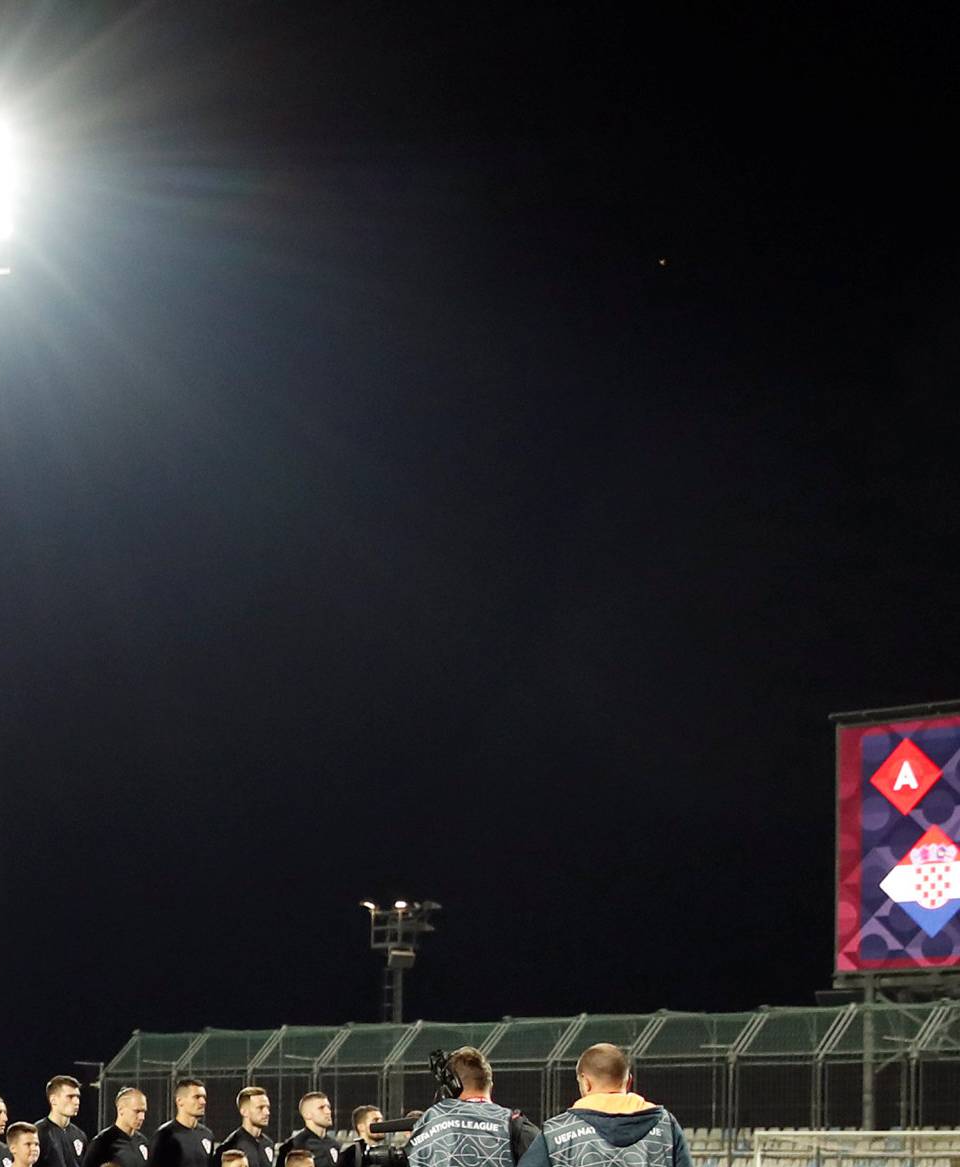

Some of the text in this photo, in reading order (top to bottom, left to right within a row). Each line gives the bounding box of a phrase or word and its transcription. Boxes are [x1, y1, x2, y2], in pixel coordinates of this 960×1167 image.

[893, 760, 919, 791] A
[409, 1119, 499, 1147] UEFA NATIONS LEAGUE
[554, 1130, 577, 1145] UEFA
